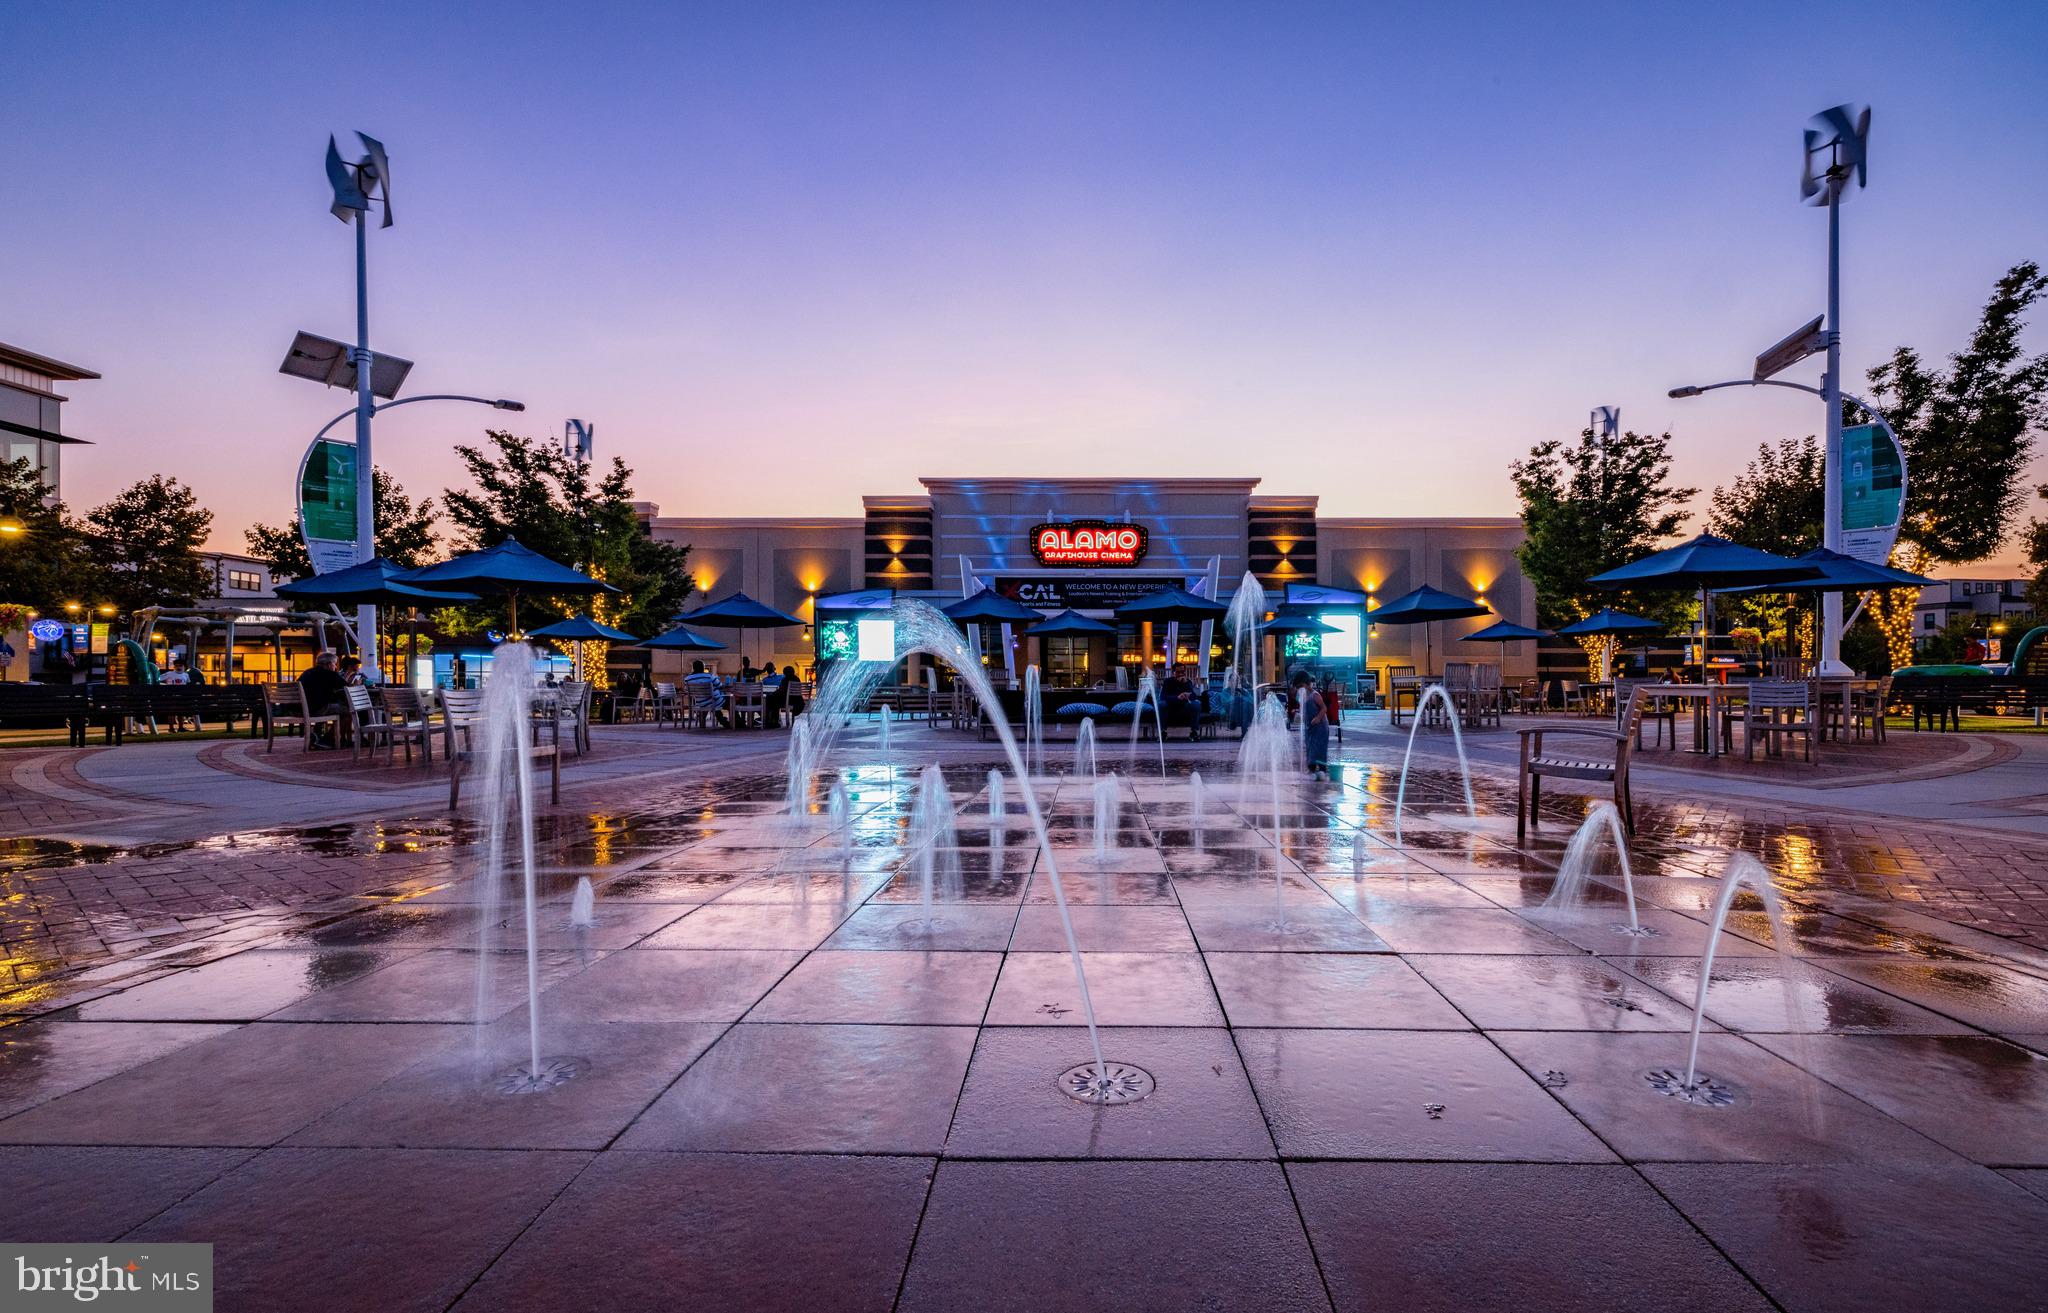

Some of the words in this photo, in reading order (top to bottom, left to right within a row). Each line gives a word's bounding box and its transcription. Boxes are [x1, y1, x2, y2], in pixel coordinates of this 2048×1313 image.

[1040, 531, 1138, 549] ALAMO
[1044, 551, 1099, 559] DRAFTHOUSE
[1100, 551, 1133, 559] CINEMA
